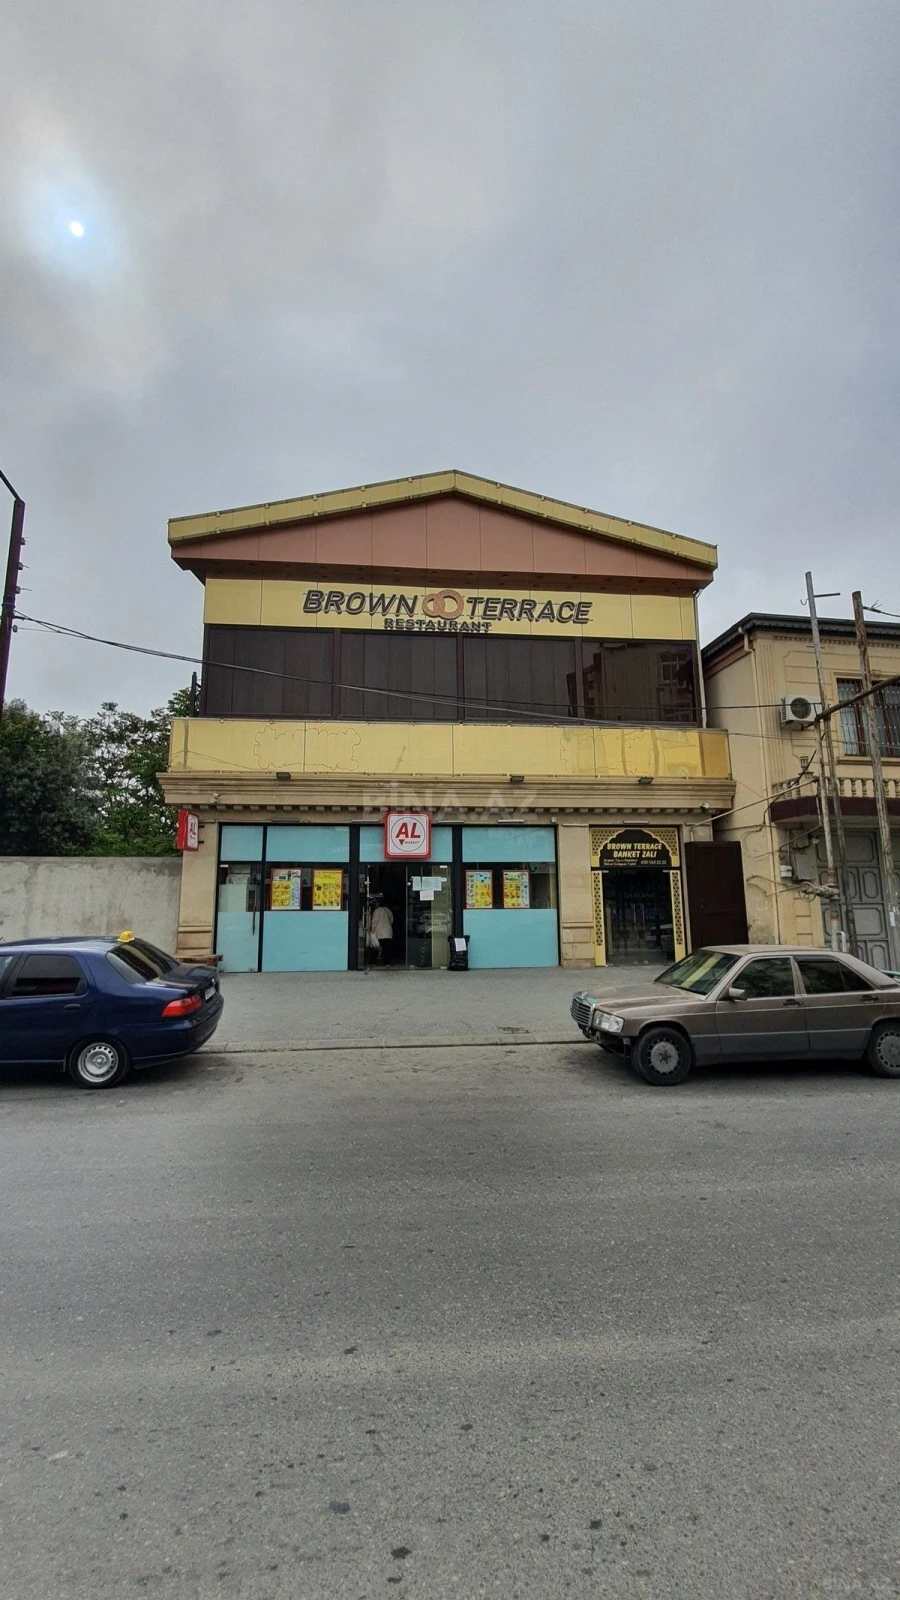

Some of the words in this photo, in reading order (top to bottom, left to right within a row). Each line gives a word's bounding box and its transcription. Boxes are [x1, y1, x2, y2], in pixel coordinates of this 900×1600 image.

[303, 589, 419, 617] BROWN
[466, 596, 594, 624] TERRACE
[383, 618, 492, 633] RESTAURANT
[395, 822, 421, 839] AL
